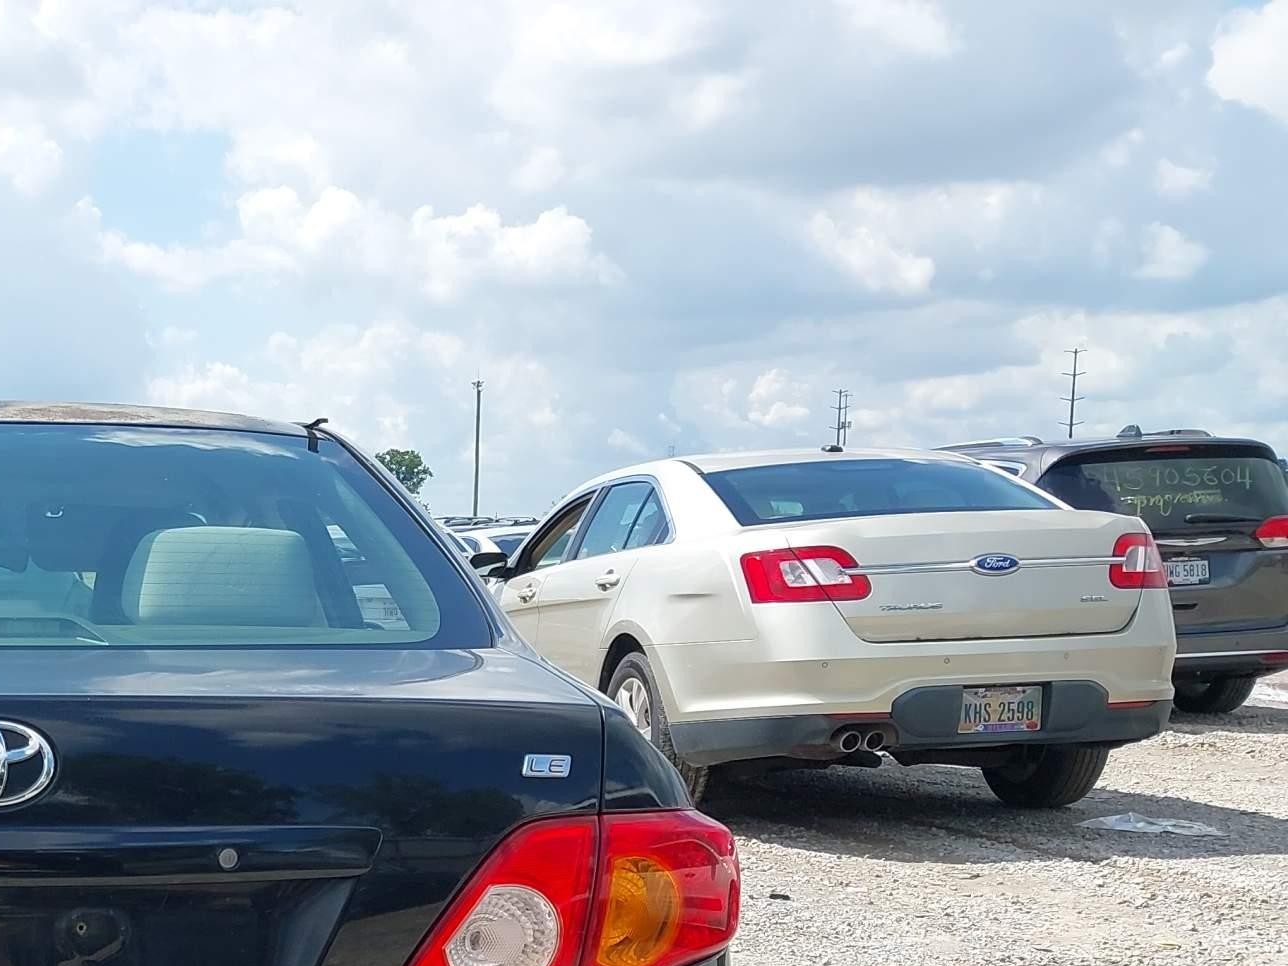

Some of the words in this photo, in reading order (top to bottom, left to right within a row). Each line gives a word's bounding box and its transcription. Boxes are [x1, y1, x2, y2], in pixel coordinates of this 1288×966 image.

[984, 556, 1011, 569] Ford
[1183, 563, 1207, 578] 5818
[964, 702, 992, 724] KHS
[997, 700, 1034, 722] 2598
